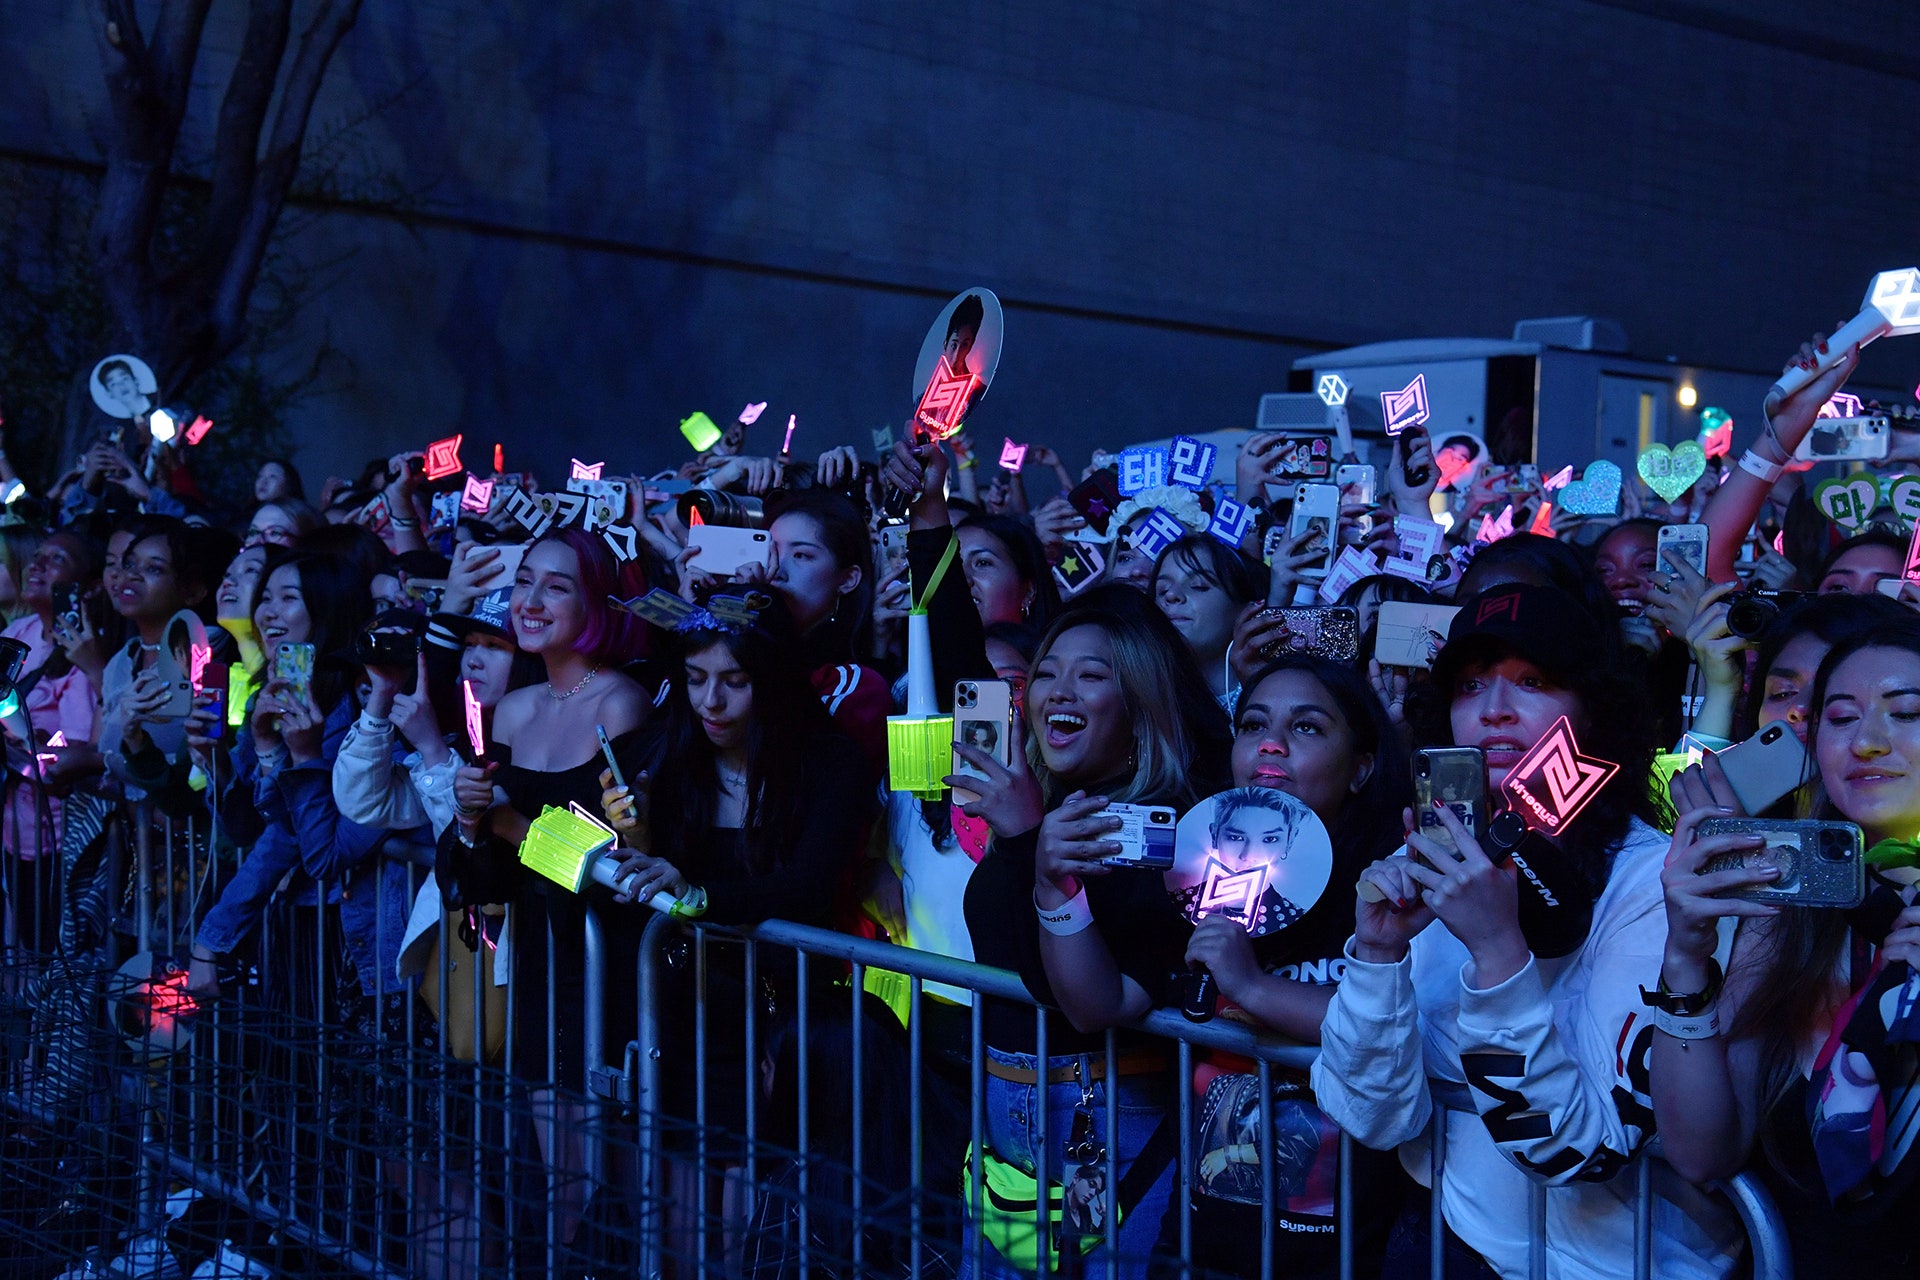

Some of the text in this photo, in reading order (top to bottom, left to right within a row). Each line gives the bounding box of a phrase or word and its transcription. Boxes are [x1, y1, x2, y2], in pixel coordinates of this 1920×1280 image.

[919, 410, 949, 433] SuperM
[1123, 440, 1212, 491] 태민
[1511, 852, 1560, 907] perM
[1279, 1219, 1335, 1233] SuperM
